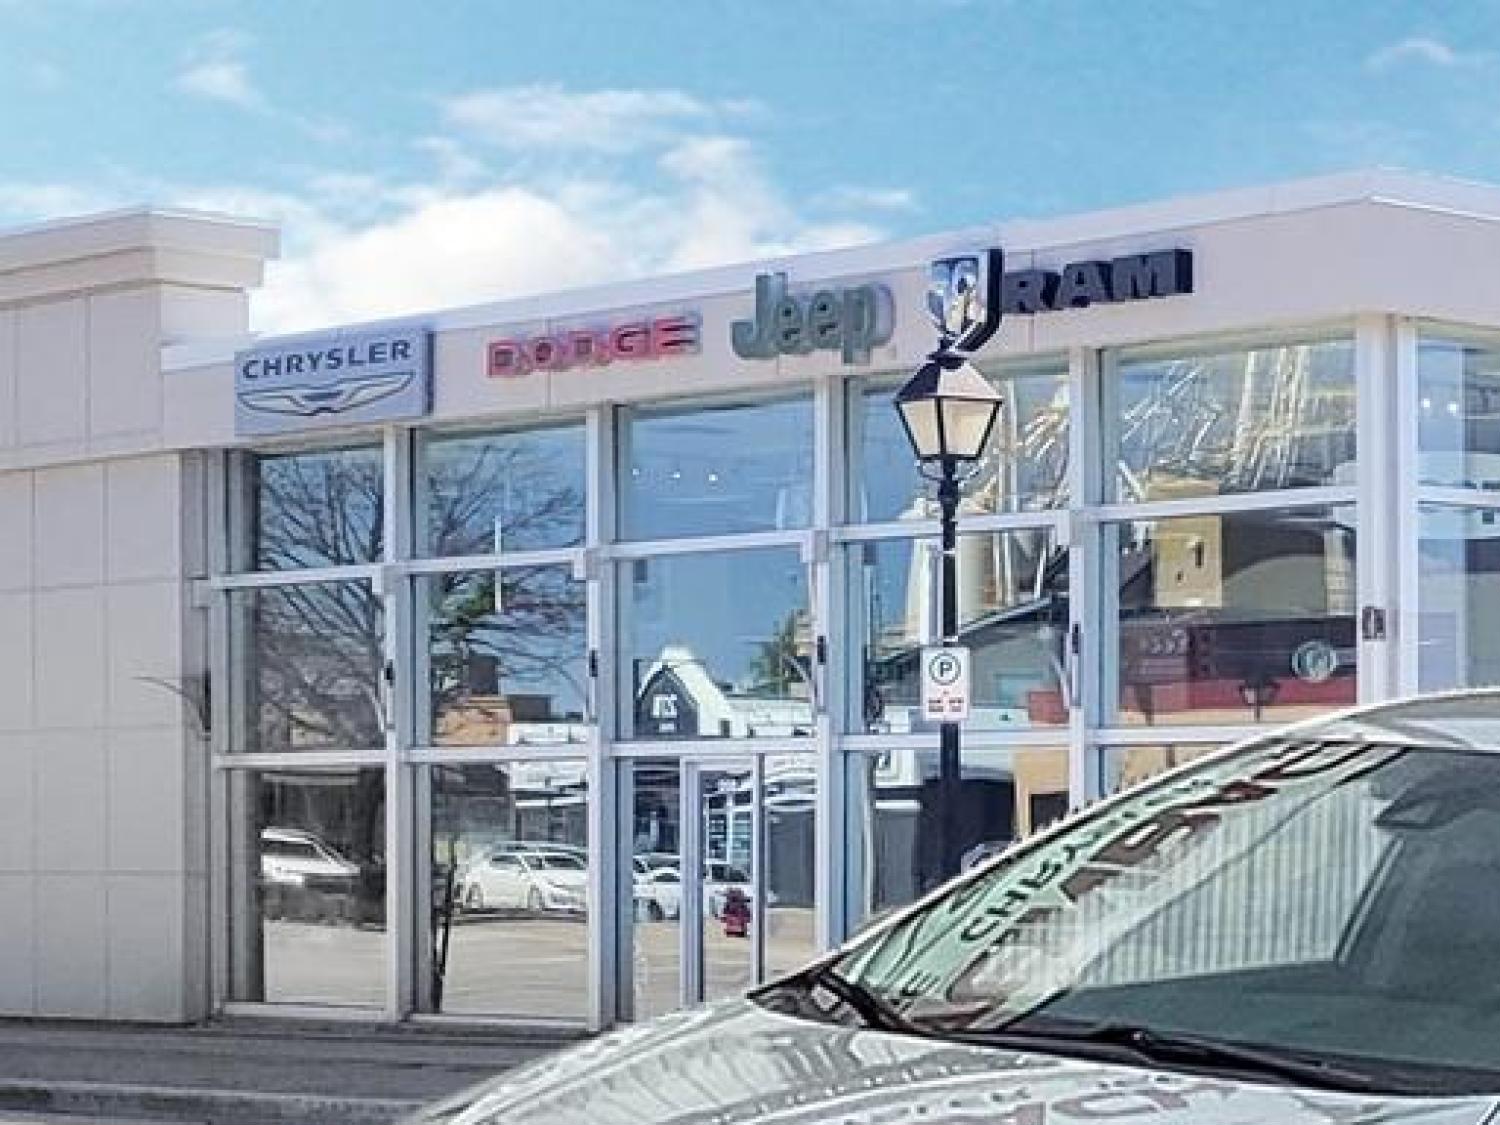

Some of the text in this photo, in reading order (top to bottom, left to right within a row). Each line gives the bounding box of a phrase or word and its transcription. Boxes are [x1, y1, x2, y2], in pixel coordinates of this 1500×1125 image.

[1001, 248, 1194, 314] RAM
[486, 314, 702, 378] DODGE
[730, 271, 896, 366] Jeep
[242, 339, 411, 379] CHRYSLER
